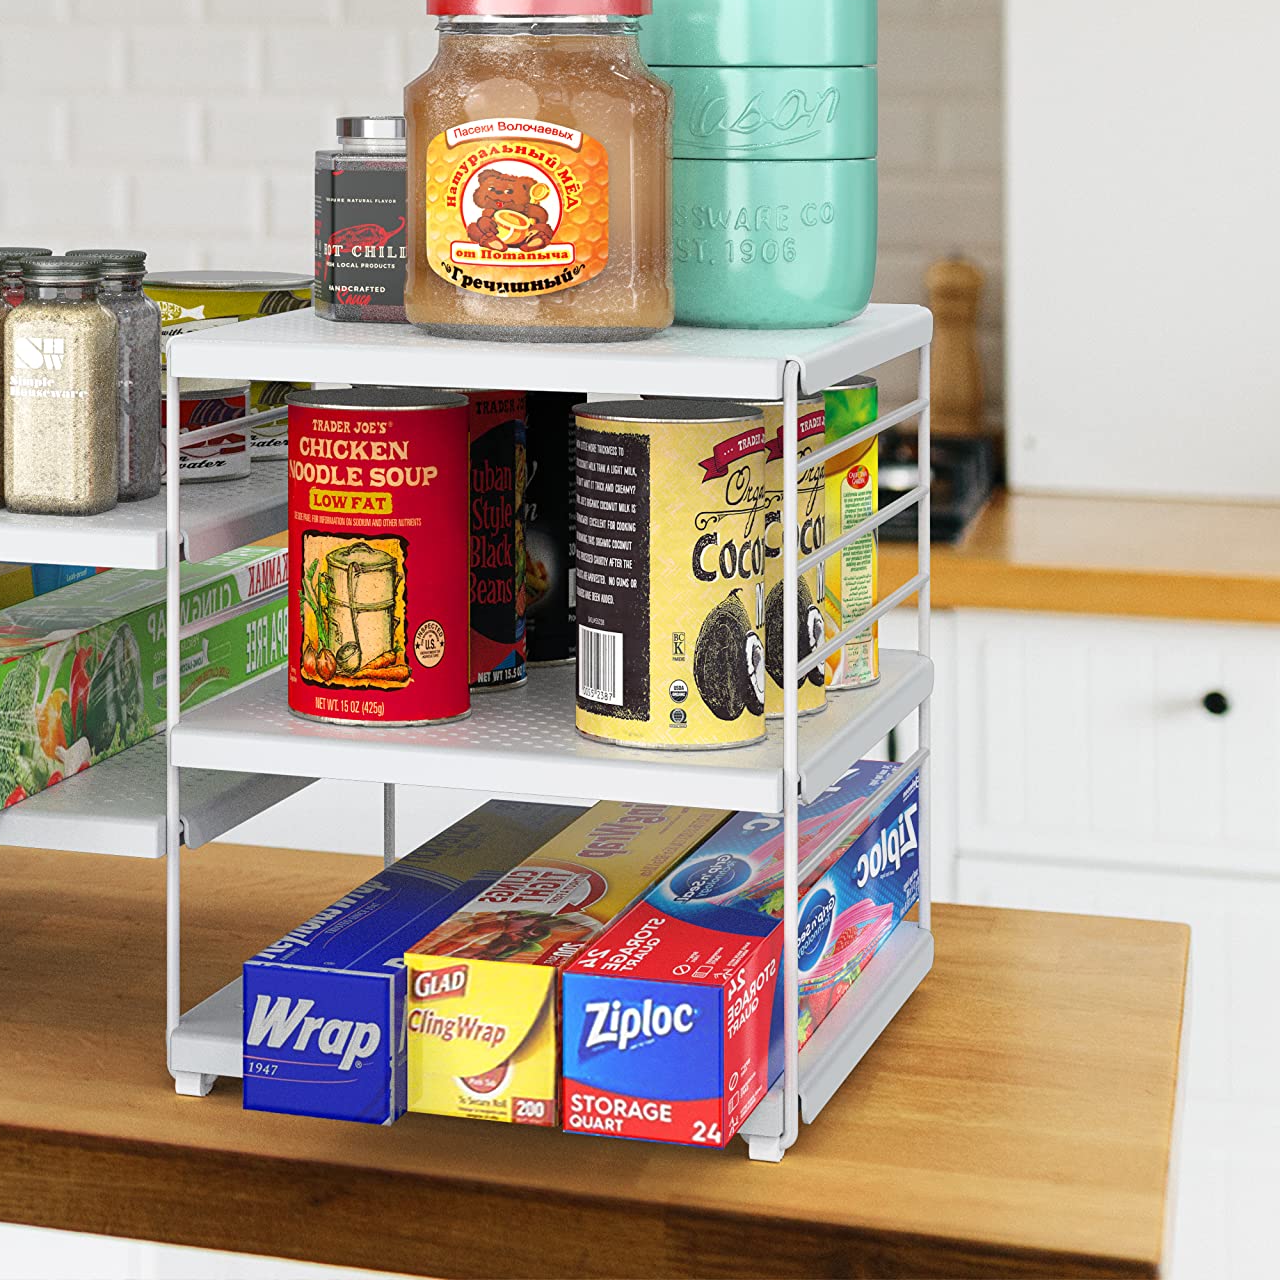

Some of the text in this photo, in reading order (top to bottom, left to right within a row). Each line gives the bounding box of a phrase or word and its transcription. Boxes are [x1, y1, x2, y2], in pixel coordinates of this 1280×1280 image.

[453, 121, 575, 141] Пасеки Волочаевых
[455, 249, 569, 260] от Потапыча
[726, 238, 796, 264] 1906
[9, 375, 55, 387] Simple
[9, 385, 88, 398] Houseware
[312, 419, 388, 434] TRADER JOE'S
[299, 436, 410, 461] CHICKEN
[289, 459, 439, 487] NOODLE SOUP
[471, 459, 513, 493] uban
[614, 483, 636, 495] CREAMY?
[313, 493, 387, 511] LOW FAT
[618, 502, 631, 513] MILK
[472, 495, 513, 537] Style
[471, 534, 513, 569] Black
[608, 557, 623, 569] AFTER
[623, 559, 633, 570] THE
[470, 572, 513, 605] Beans
[416, 622, 443, 640] INSPECTED
[674, 642, 684, 655] K
[477, 670, 503, 683] NET WT
[315, 696, 385, 716] NET WT. 15 OZ (425g)
[414, 970, 466, 998] GLAD
[246, 994, 381, 1071] Wrap
[585, 998, 694, 1051] Ziploc
[248, 1061, 279, 1076] 1947
[516, 1100, 545, 1118] 200
[571, 1094, 673, 1123] STORAGE
[568, 1114, 624, 1132] QUART
[692, 1120, 721, 1144] 24
